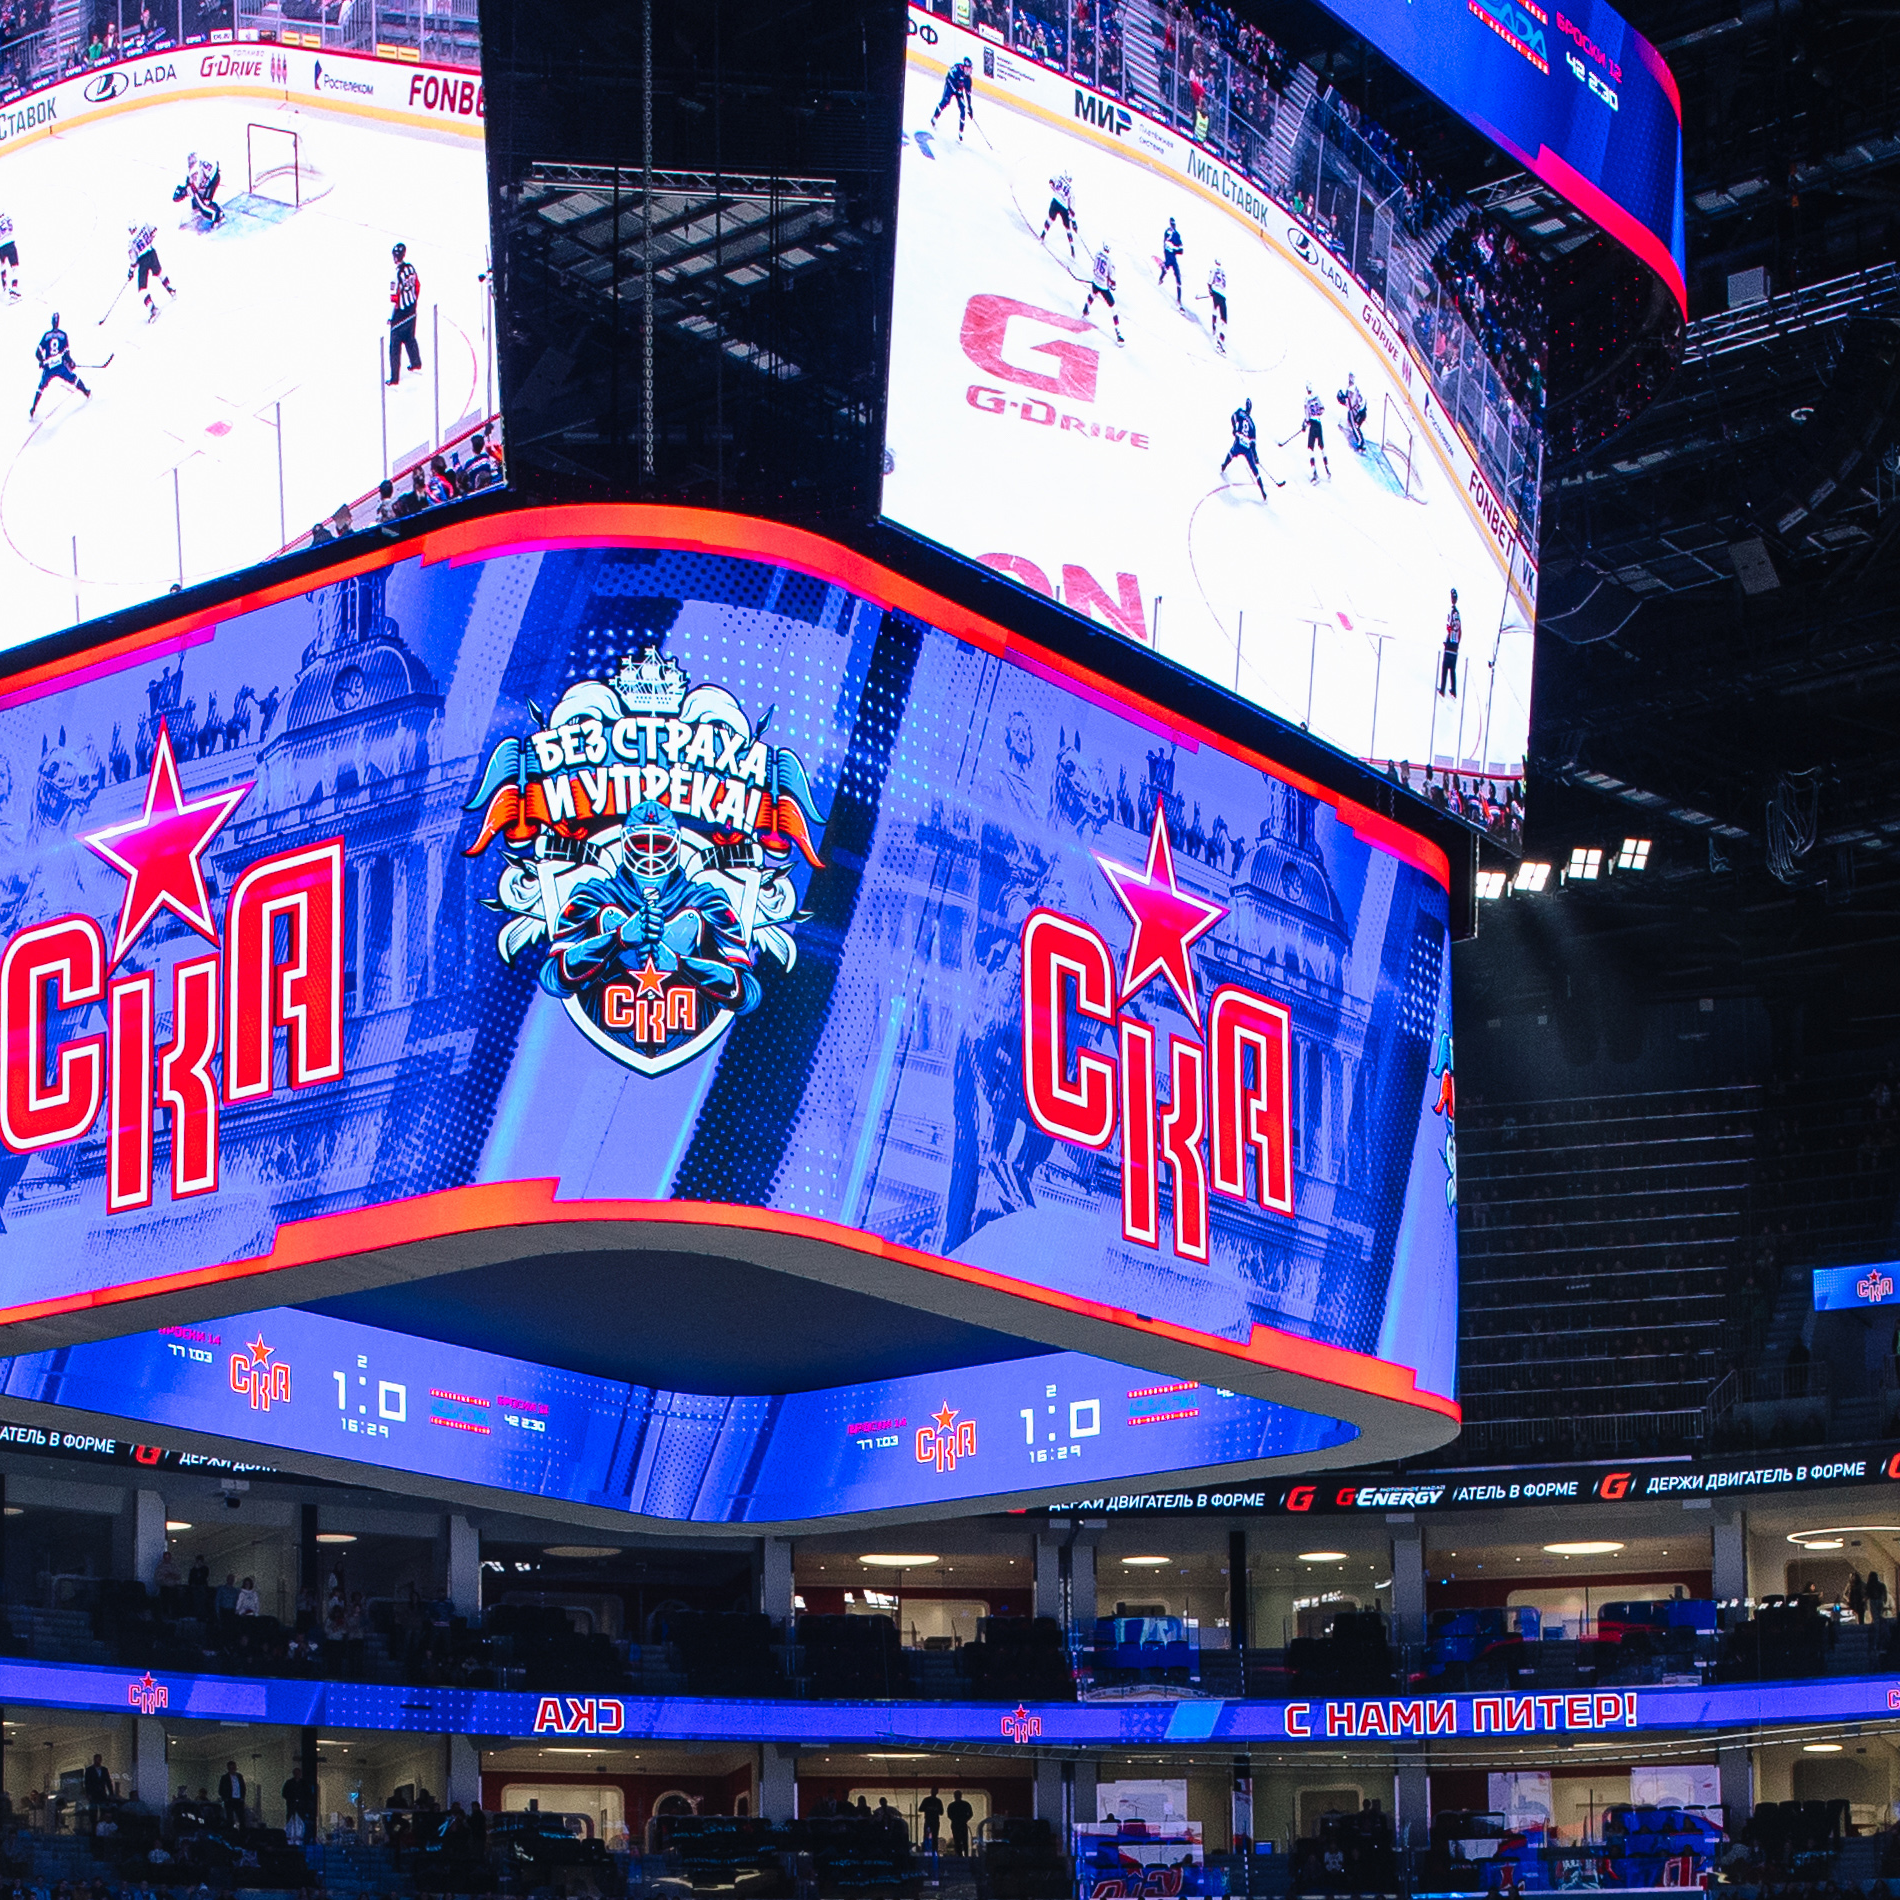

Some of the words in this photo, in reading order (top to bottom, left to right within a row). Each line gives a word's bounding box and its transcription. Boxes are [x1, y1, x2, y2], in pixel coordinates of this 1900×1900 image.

[1557, 11, 1606, 70] БРОСКИ
[134, 65, 178, 89] LADA
[1566, 51, 1586, 83] 42
[1321, 256, 1350, 299] LADA
[1469, 467, 1516, 558] FONBET
[530, 724, 604, 771] БЕЗ
[609, 718, 767, 781] СТРАХА
[545, 775, 574, 819] И
[604, 982, 696, 1043] СКА
[1021, 906, 1294, 1265] СКА
[230, 1354, 291, 1412] СКА
[357, 1355, 368, 1369] 2
[333, 1371, 407, 1423] 1:0
[340, 1417, 389, 1438] 16:29
[1020, 1399, 1101, 1445] 1:0
[916, 1420, 977, 1474] СКА
[1029, 1446, 1081, 1464] 16:29
[1647, 1474, 1703, 1495] ДЕРЖИ
[1705, 1468, 1793, 1491] ДВИГАТЕЛЬ
[1797, 1466, 1807, 1480] В
[1811, 1461, 1867, 1480] ФОРМЕ
[1106, 1493, 1194, 1512] ДВИГАТЕЛЬ
[1197, 1493, 1208, 1508] В
[1211, 1491, 1266, 1508] ФОРМЕ
[1284, 1702, 1312, 1739] С
[1326, 1699, 1458, 1738] НАМИ
[1472, 1691, 1639, 1735] ПИТЕР!
